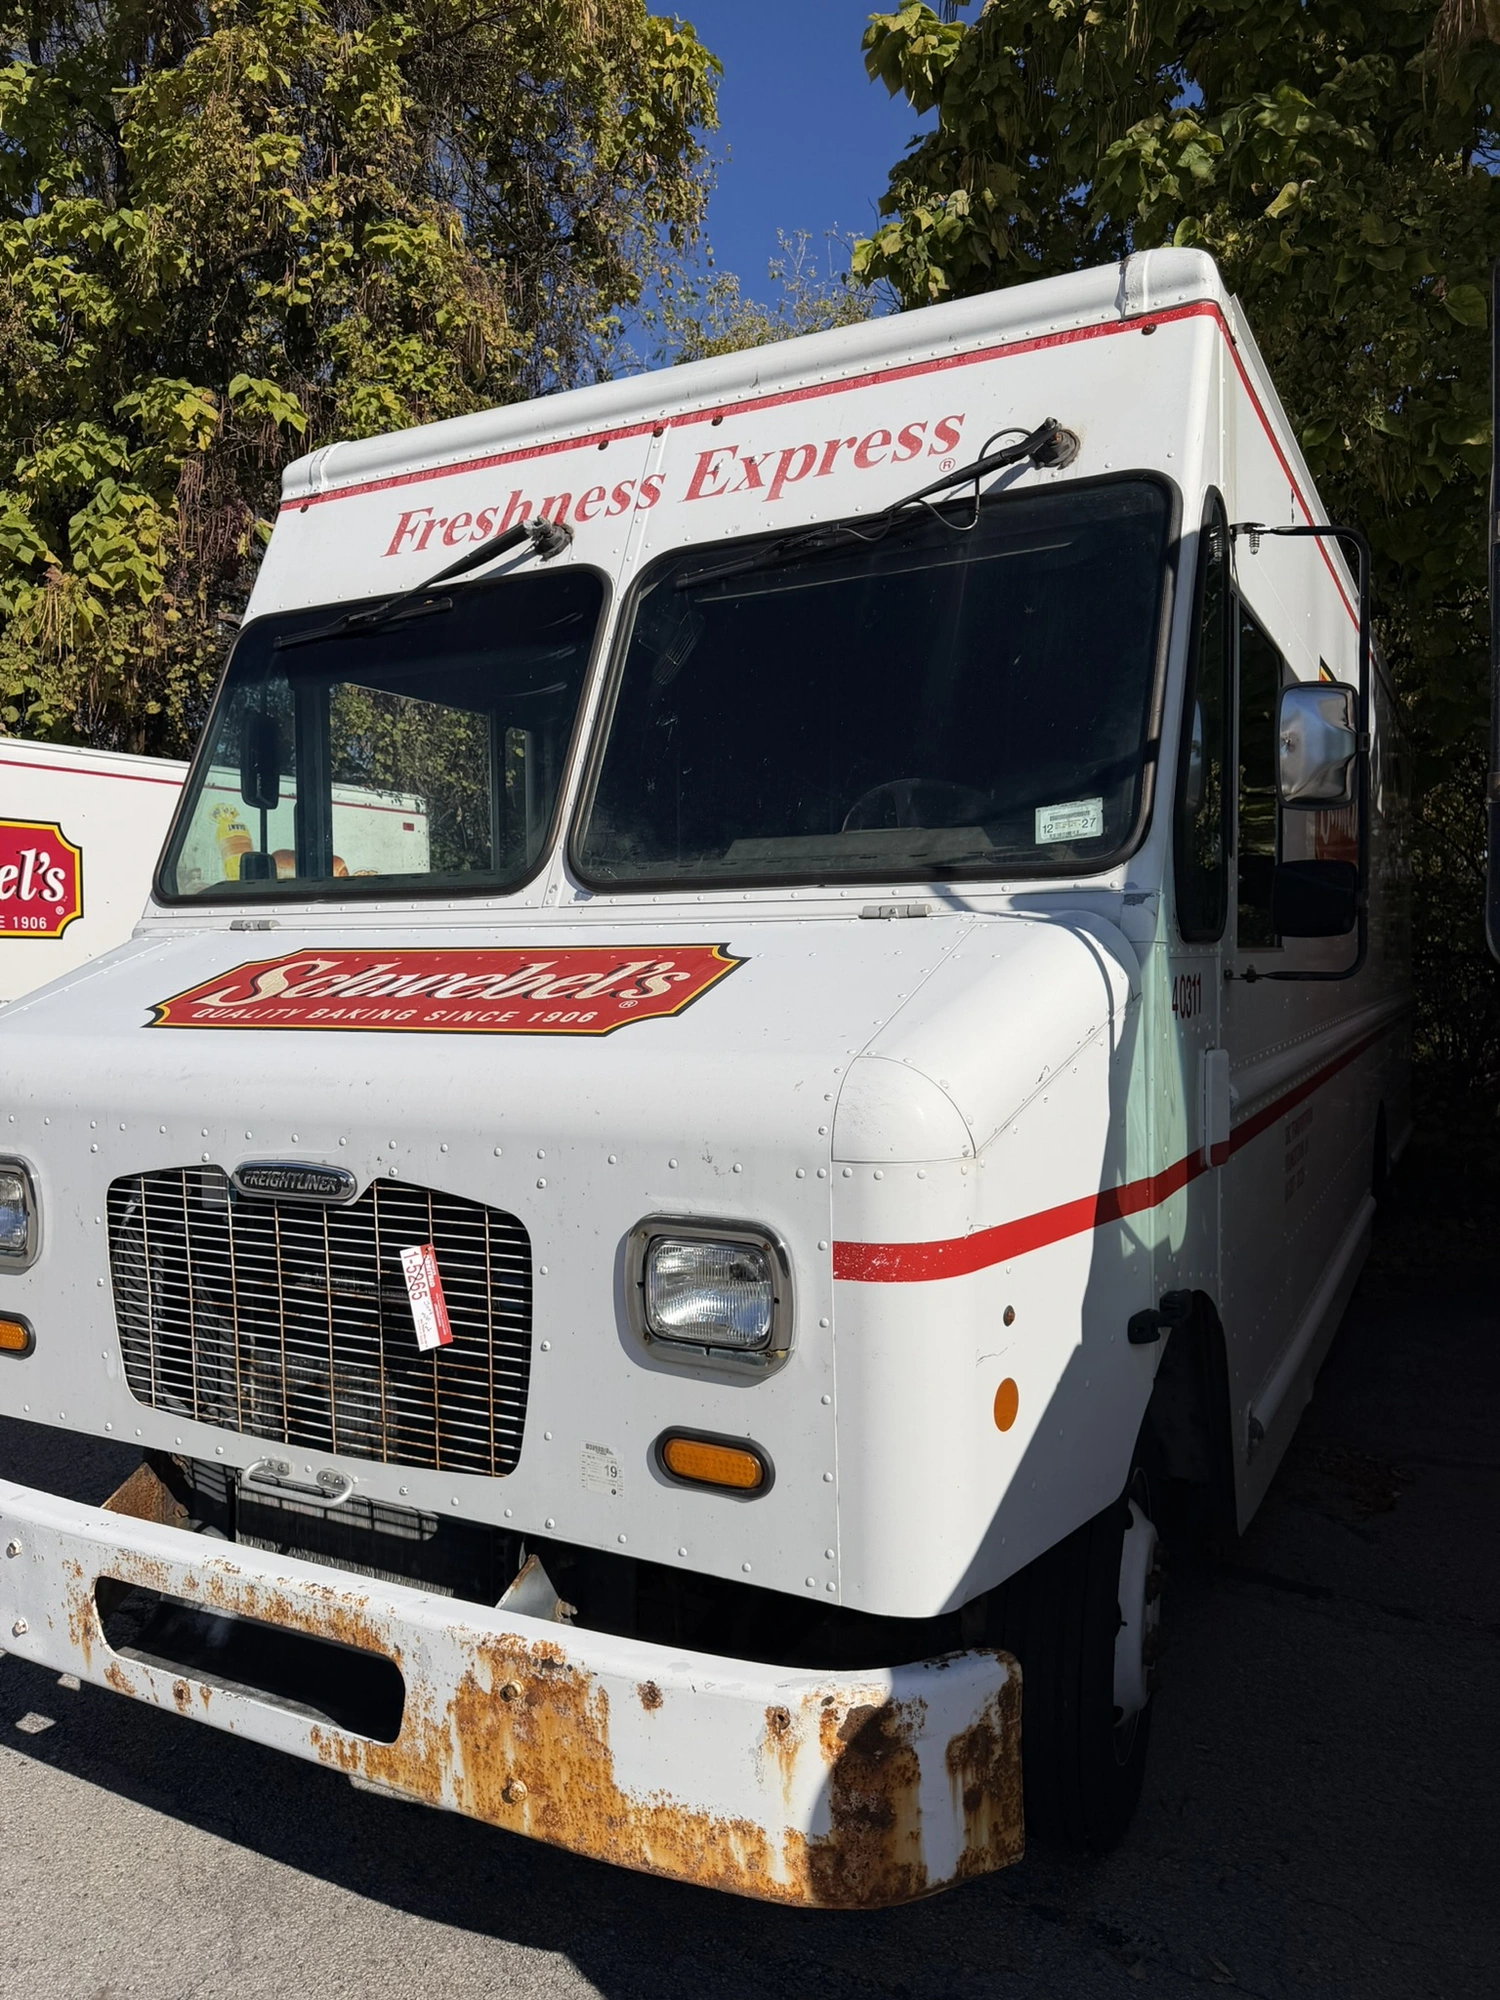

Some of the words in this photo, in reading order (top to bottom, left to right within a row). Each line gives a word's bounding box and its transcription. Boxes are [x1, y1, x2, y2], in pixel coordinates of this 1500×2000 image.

[380, 472, 667, 558] Freshness
[678, 412, 967, 503] Express
[1042, 823, 1054, 834] 12
[1081, 817, 1097, 829] 27
[13, 915, 47, 930] 1906
[190, 960, 691, 1007] Schwebel's
[1171, 972, 1202, 1021] 40311
[191, 1007, 303, 1020] QUALITY
[304, 1008, 418, 1022] BAKING
[423, 1010, 520, 1023] SINCE
[527, 1010, 599, 1024] 1906
[243, 1169, 338, 1193] FREIGHTLINER
[403, 1250, 429, 1301] 1-5265
[604, 1464, 618, 1479] 19
